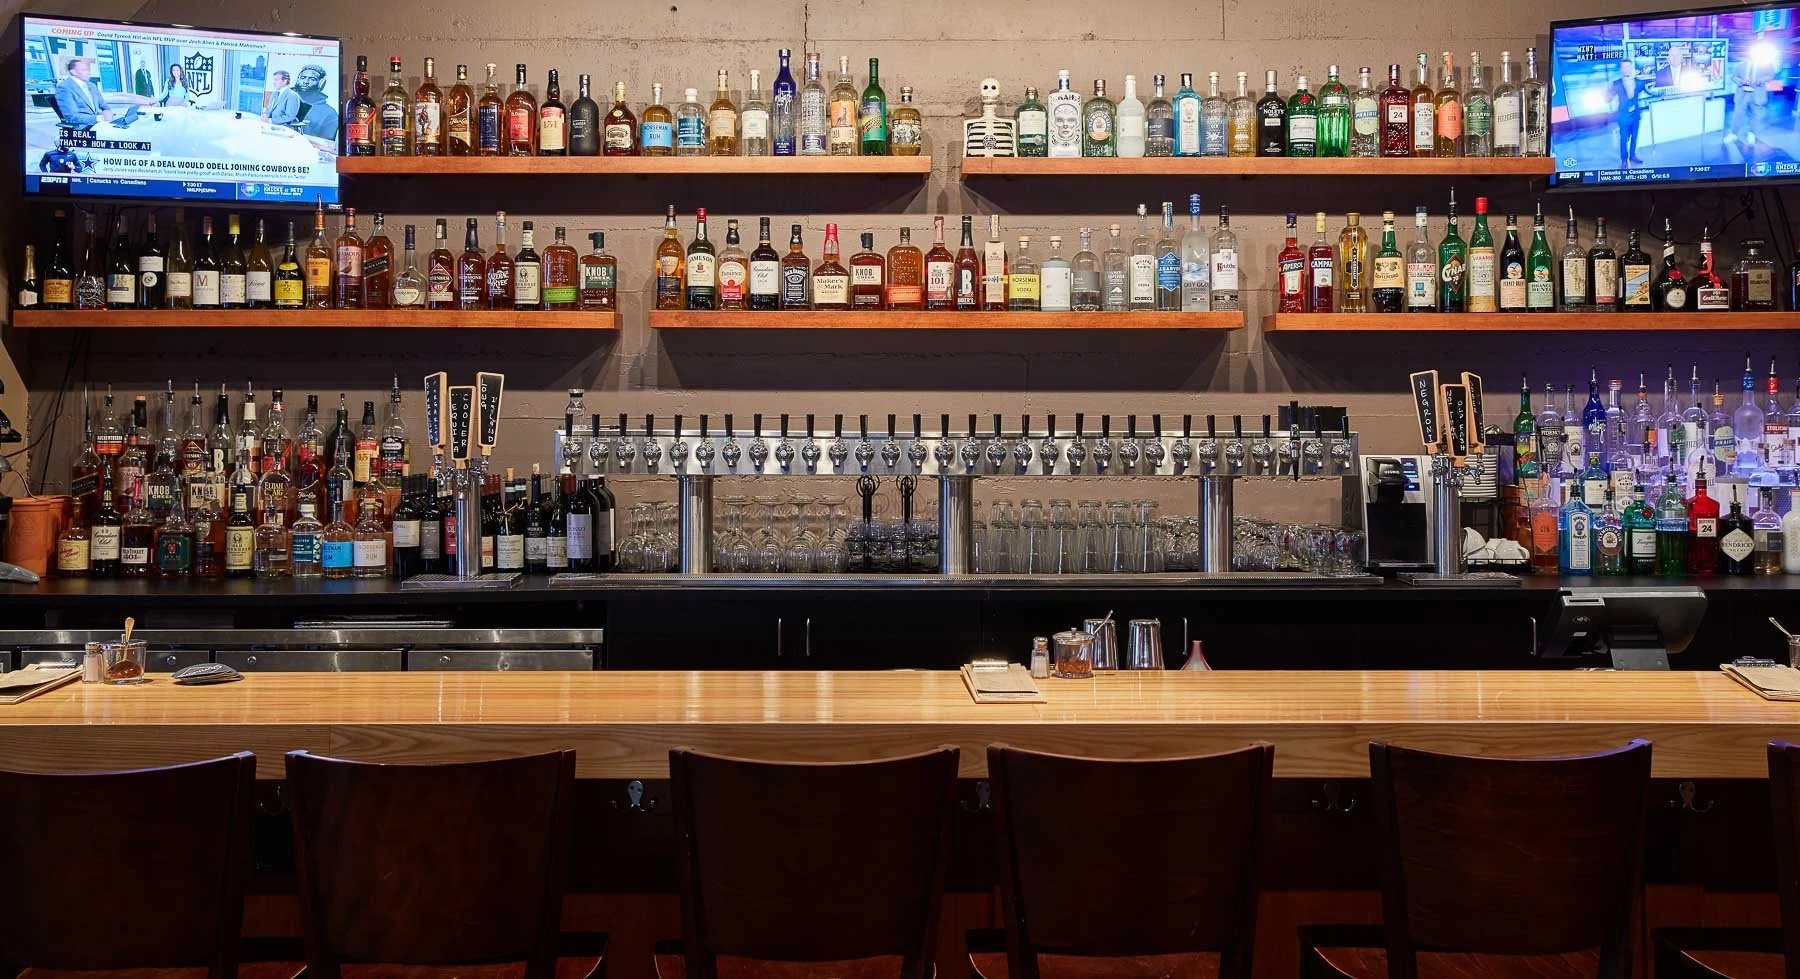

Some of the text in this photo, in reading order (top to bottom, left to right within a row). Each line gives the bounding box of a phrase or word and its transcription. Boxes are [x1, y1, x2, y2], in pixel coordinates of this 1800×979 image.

[1602, 52, 1624, 60] THERE
[186, 71, 210, 93] NFL
[1393, 111, 1404, 119] 24
[59, 130, 96, 139] IS REAL.
[60, 139, 87, 147] THAT'S
[91, 140, 107, 148] HOW
[119, 142, 138, 150] LOOK
[141, 143, 151, 151] AT
[103, 158, 310, 175] HOW BIG OF A DEAL WOULD ODELL JOINING COWBOYS BE?
[1559, 172, 1581, 180] ESPN
[688, 255, 714, 264] JAMESON
[586, 266, 608, 277] KNOB
[855, 268, 873, 276] KNOB
[930, 277, 945, 285] 101
[961, 269, 973, 295] B
[1418, 379, 1434, 443] NEGRONI
[461, 393, 470, 447] COOLER
[213, 448, 225, 475] B
[148, 485, 170, 495] KNOB
[264, 488, 283, 497] CAIG
[1701, 525, 1713, 533] 24
